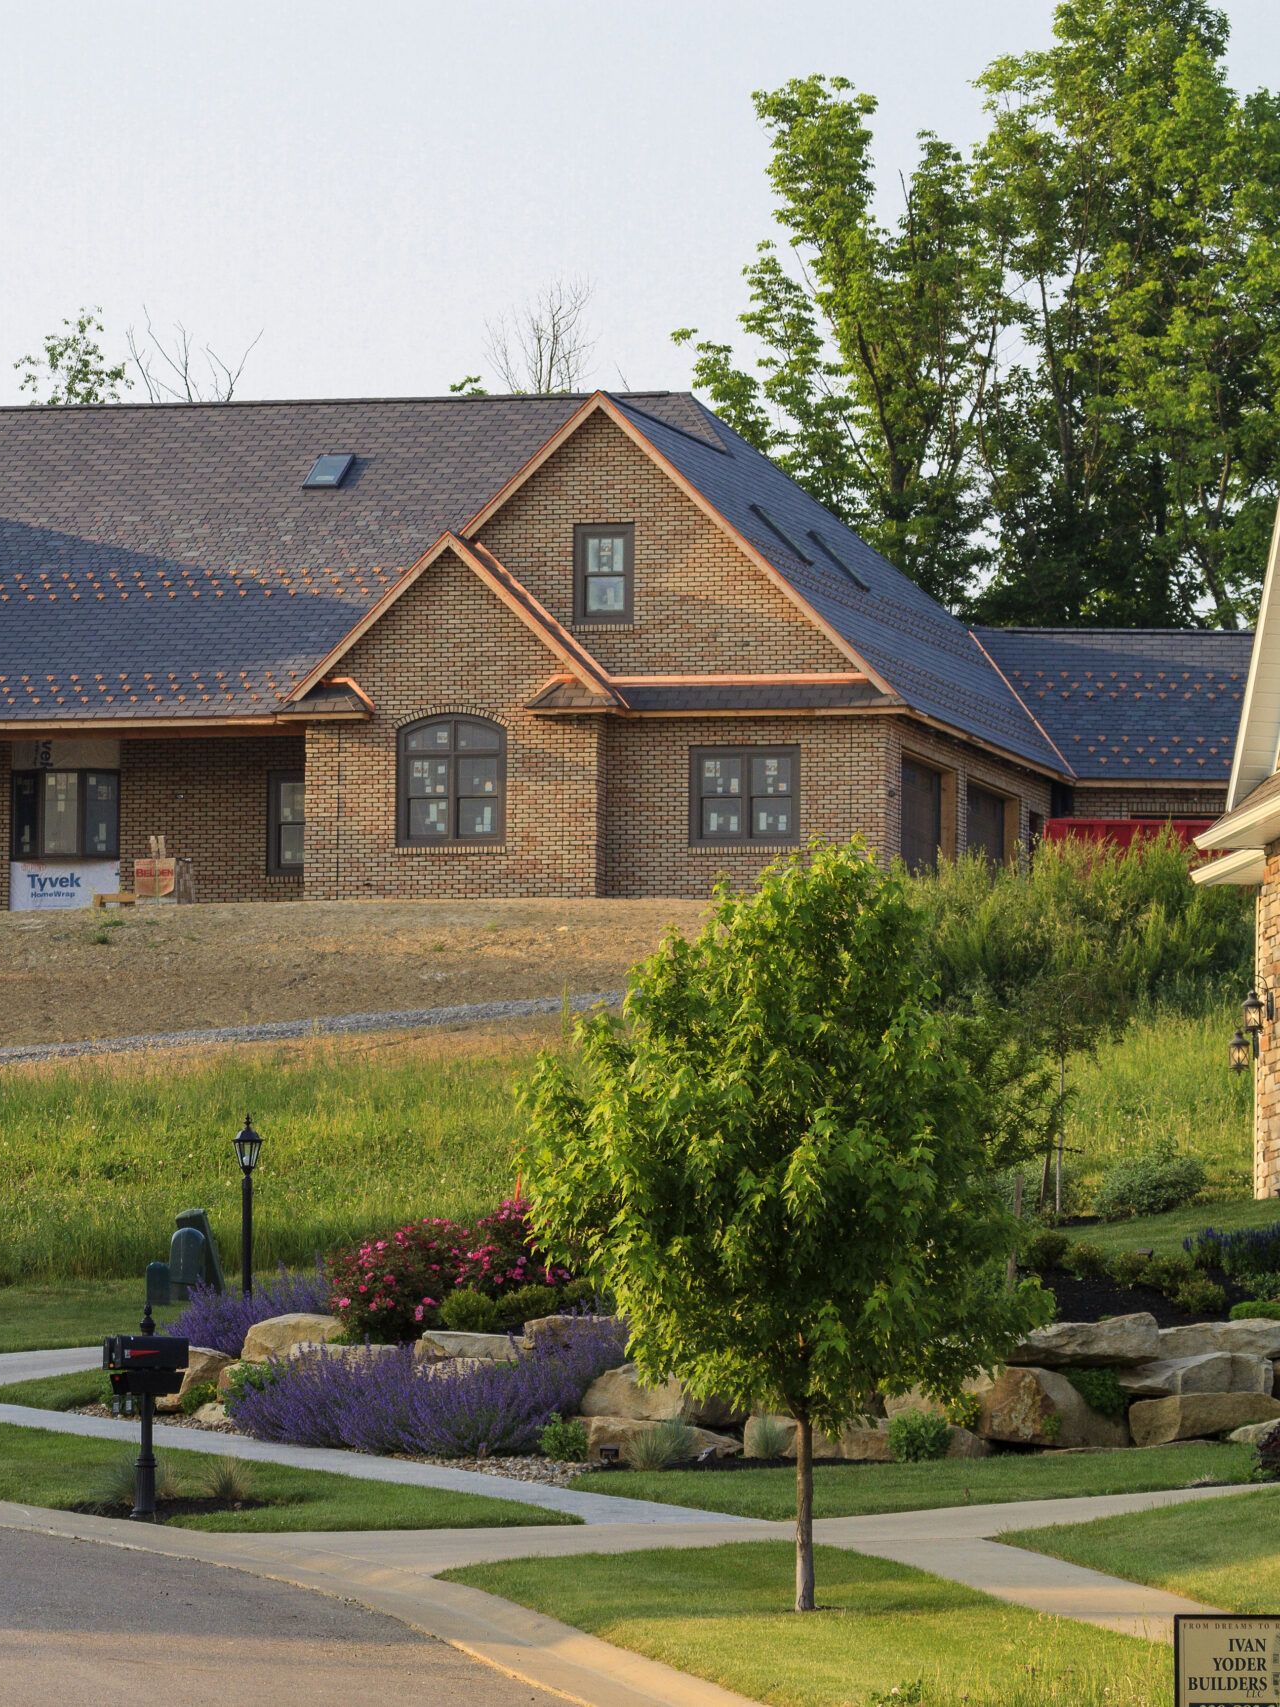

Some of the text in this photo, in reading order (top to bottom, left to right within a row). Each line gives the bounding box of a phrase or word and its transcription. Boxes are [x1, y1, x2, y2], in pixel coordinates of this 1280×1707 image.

[27, 873, 81, 891] Tyvek
[30, 890, 75, 899] HomeWrap
[1228, 1638, 1267, 1652] IVAN
[1213, 1657, 1267, 1671] YODER
[1188, 1676, 1268, 1691] BUILDERS
[1245, 1689, 1264, 1698] LLC
